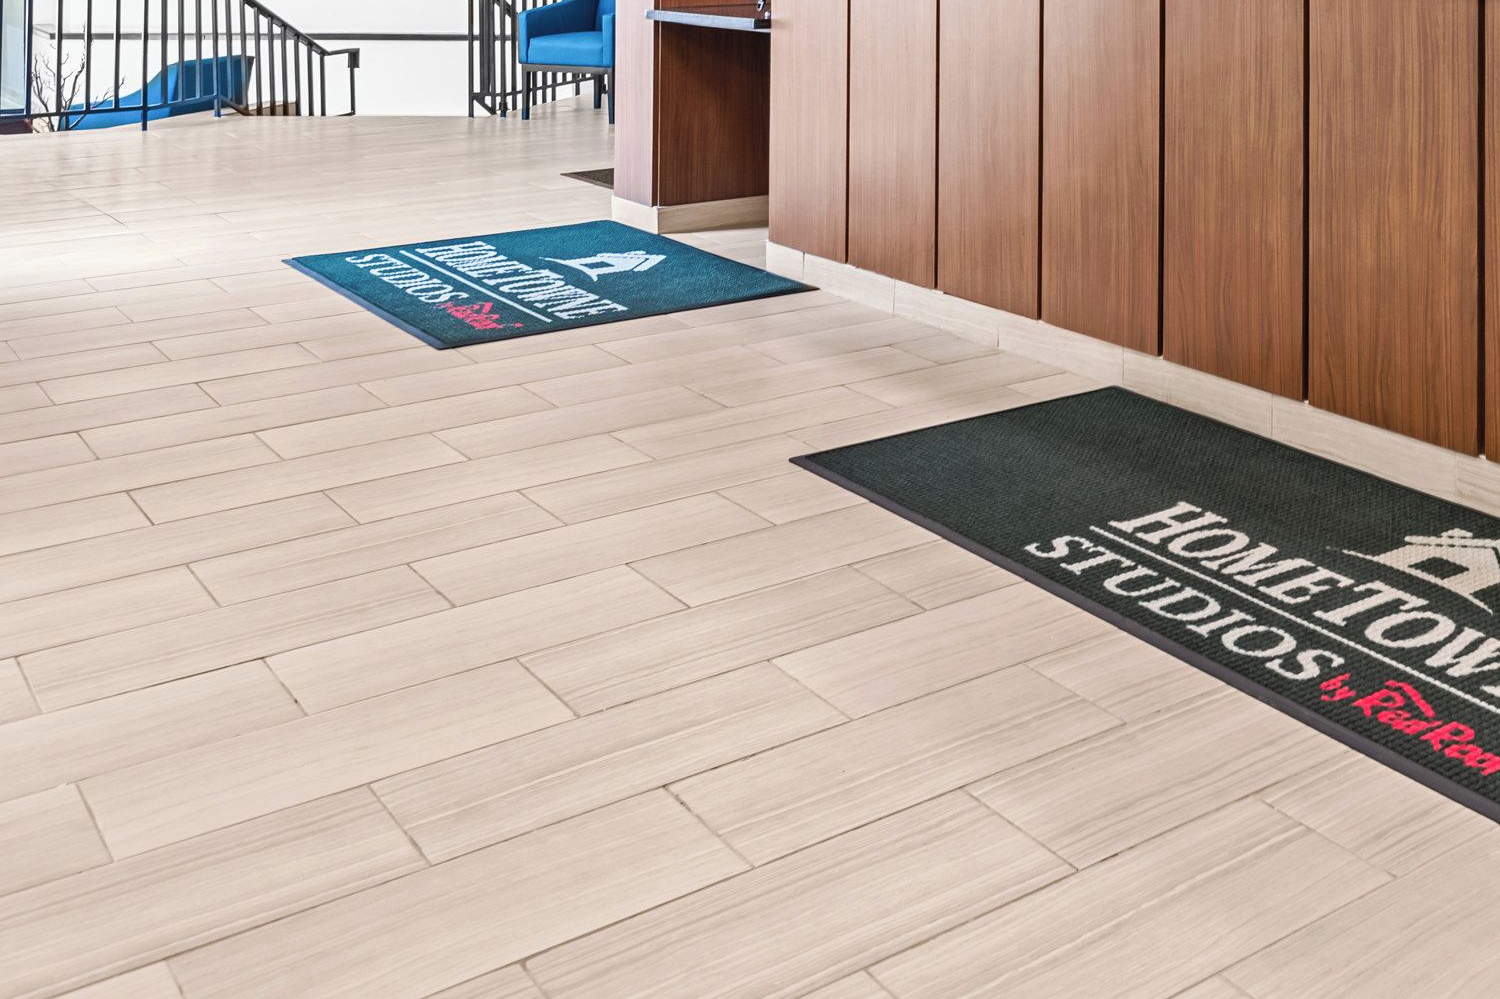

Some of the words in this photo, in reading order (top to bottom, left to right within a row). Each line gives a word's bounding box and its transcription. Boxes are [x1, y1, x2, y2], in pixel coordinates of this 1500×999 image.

[345, 253, 470, 304] STUDIOS
[1025, 534, 1345, 682] STUDIOS
[1319, 673, 1356, 701] by
[1352, 684, 1442, 735] Red
